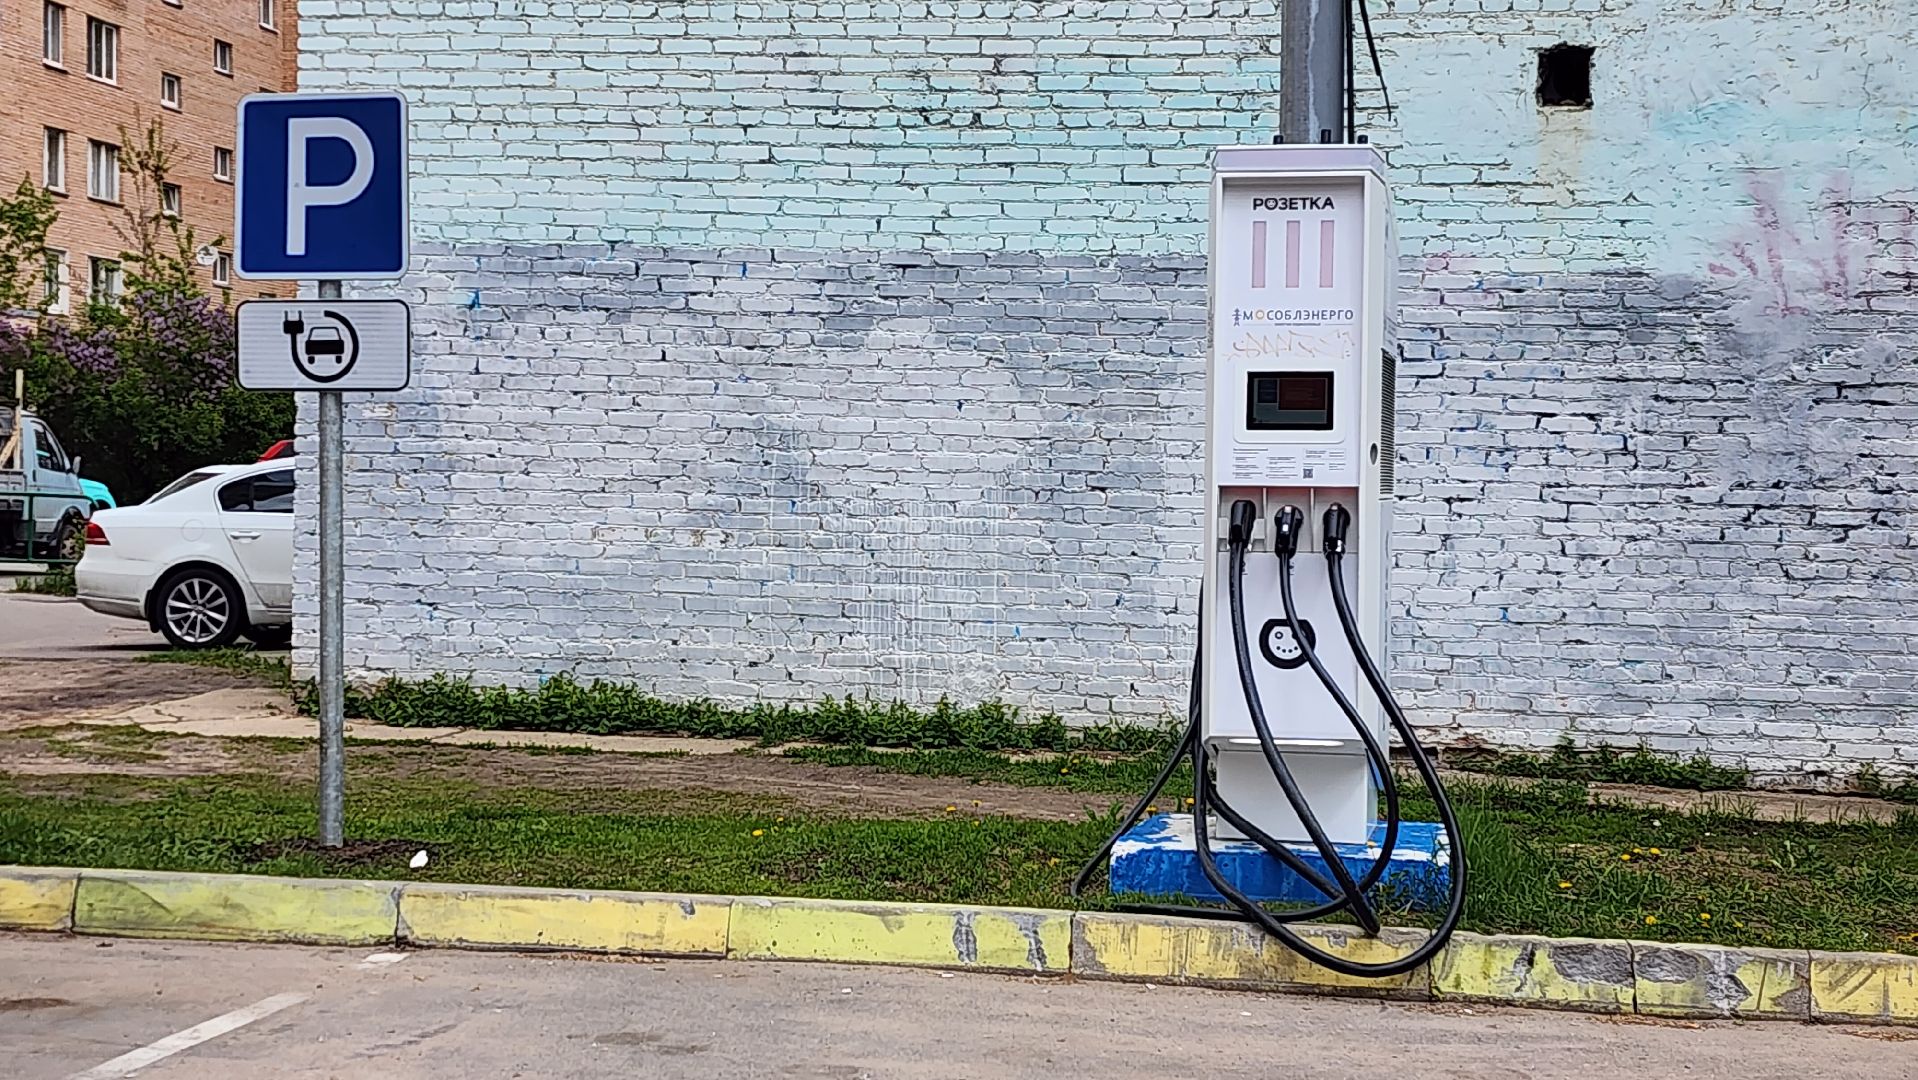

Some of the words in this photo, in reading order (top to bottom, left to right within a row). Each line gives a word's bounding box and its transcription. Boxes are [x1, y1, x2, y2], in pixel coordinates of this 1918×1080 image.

[286, 117, 374, 256] P
[1253, 197, 1335, 210] РОЗЕТКА
[1242, 309, 1354, 321] МОСОБЛЭНЕРГО
